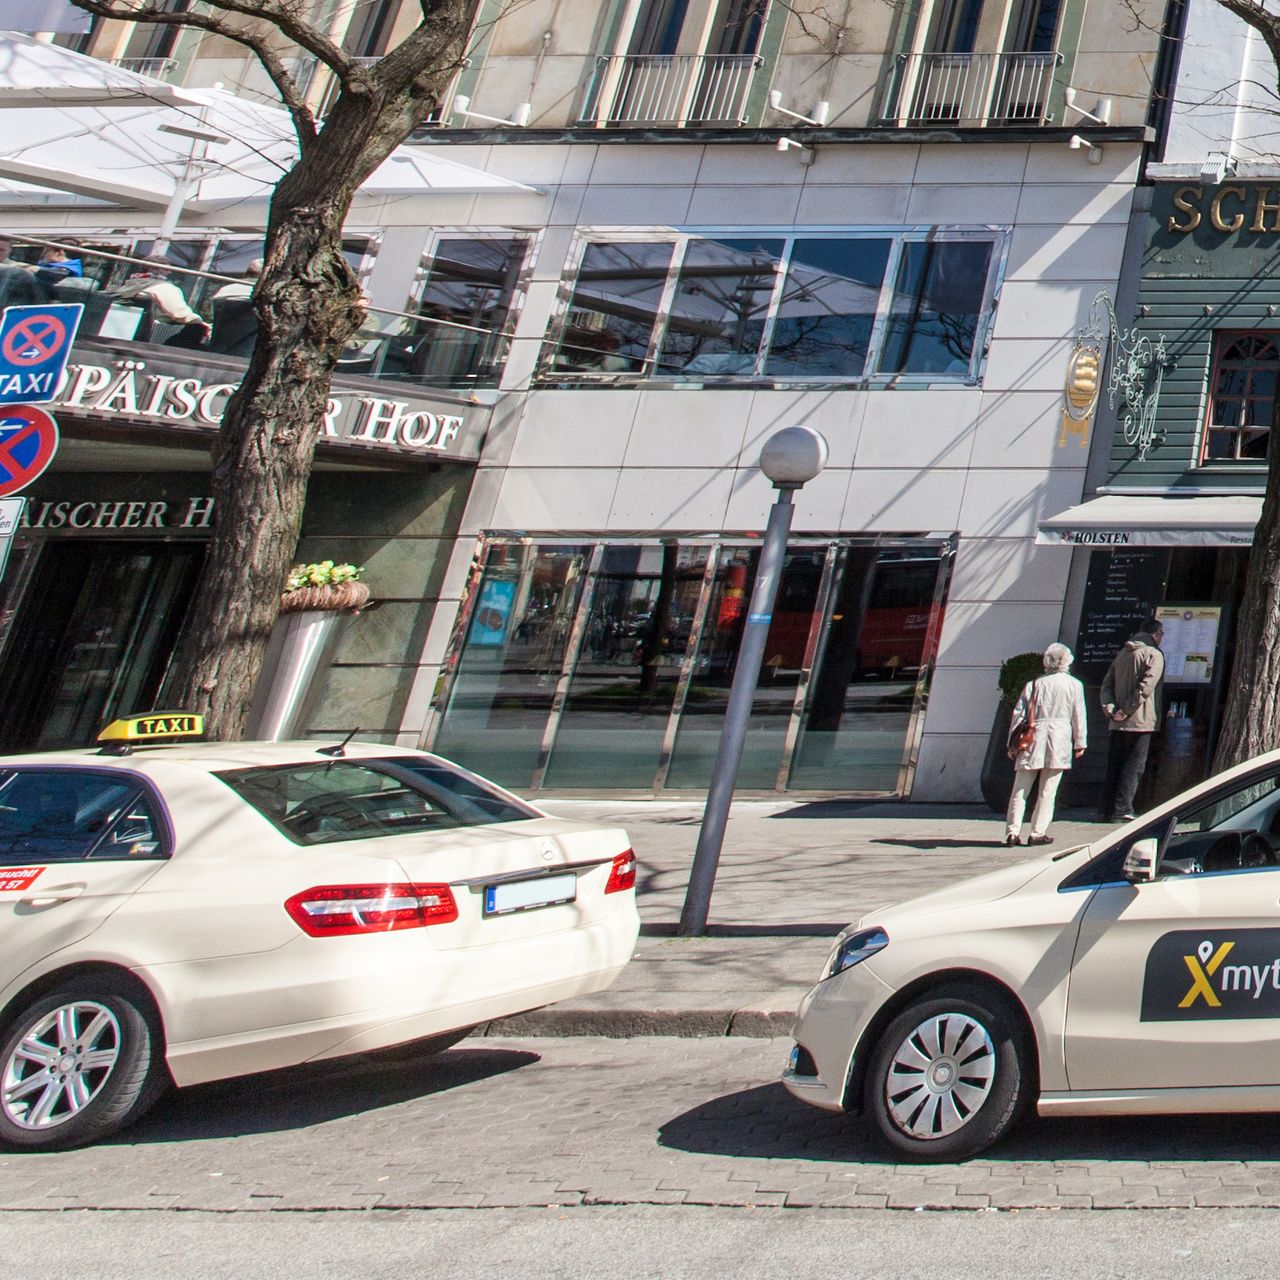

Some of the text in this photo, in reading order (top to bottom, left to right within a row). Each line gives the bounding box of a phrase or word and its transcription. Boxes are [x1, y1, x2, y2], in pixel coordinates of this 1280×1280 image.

[349, 396, 464, 450] HOF
[1074, 531, 1131, 544] HOLSTEN
[144, 719, 189, 733] TAXI
